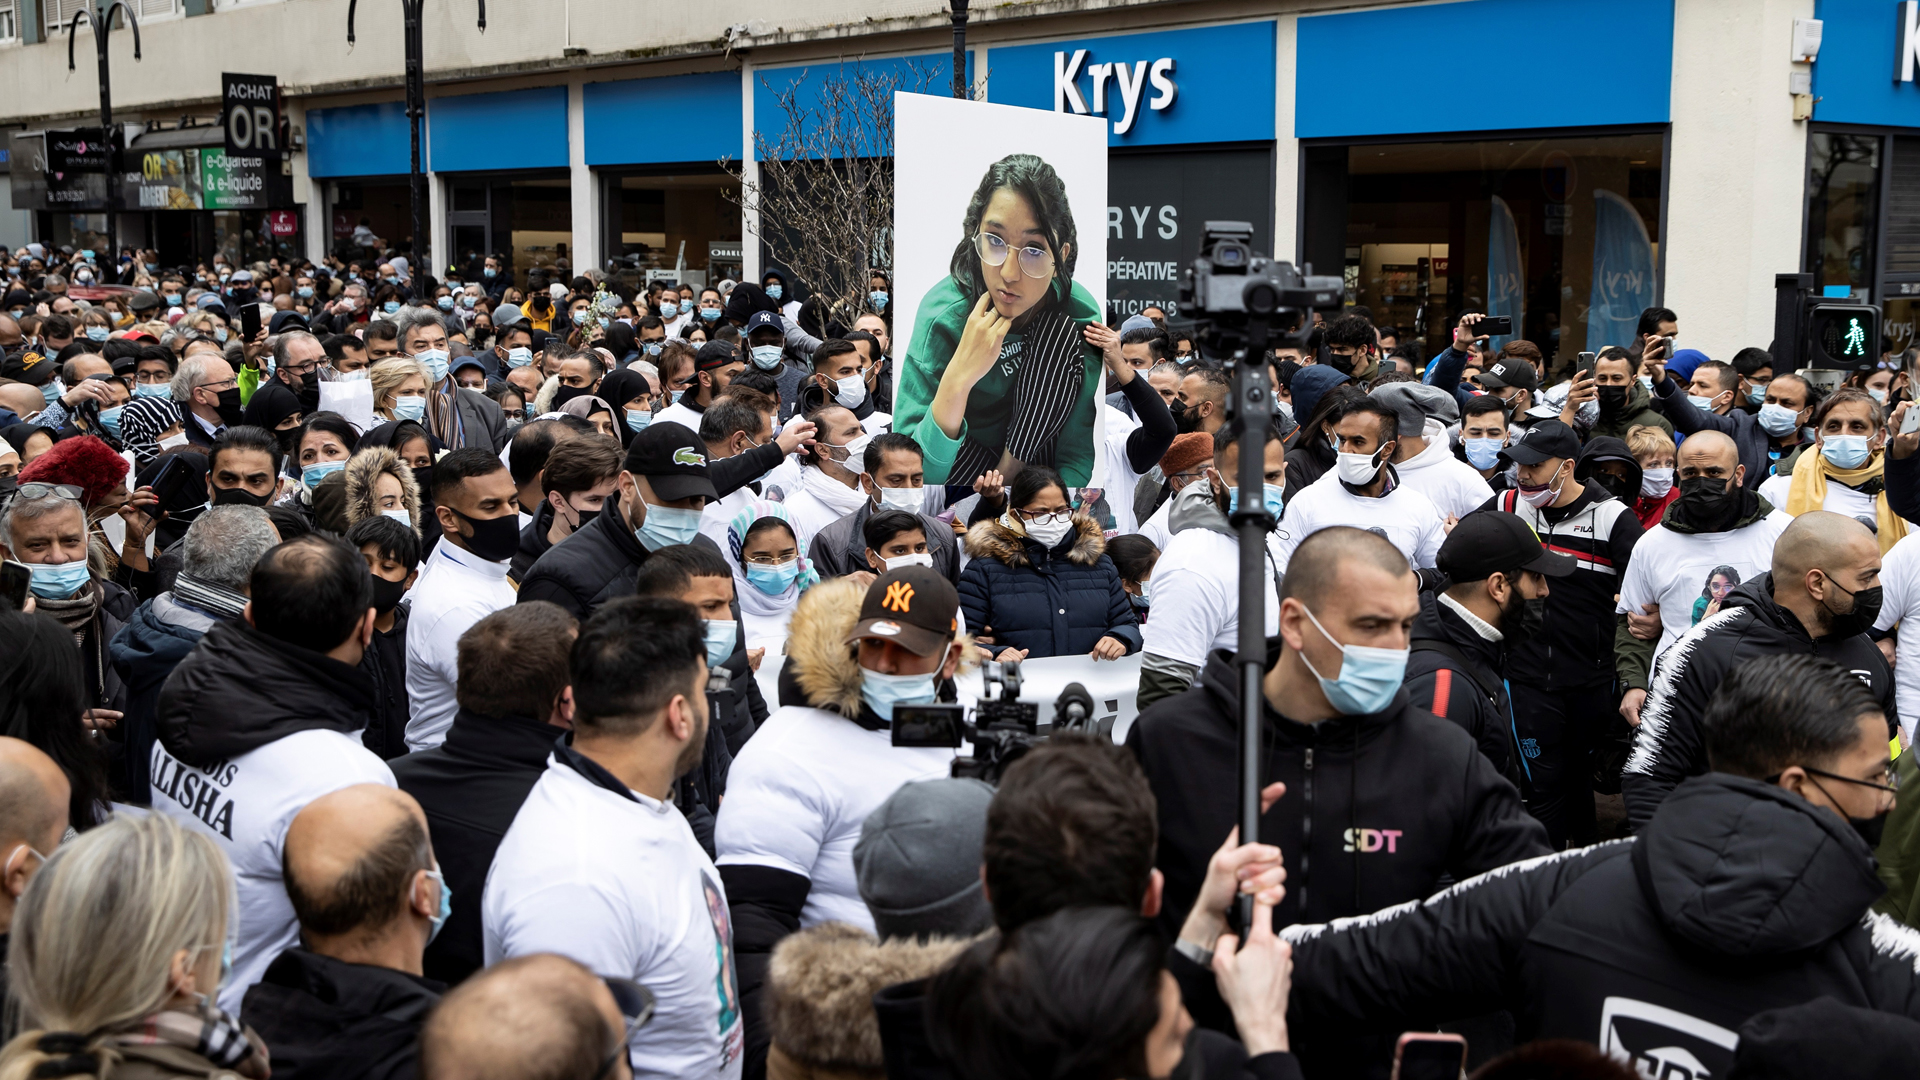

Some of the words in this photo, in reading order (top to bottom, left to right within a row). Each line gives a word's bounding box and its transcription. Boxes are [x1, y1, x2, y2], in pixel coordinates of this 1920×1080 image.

[228, 83, 273, 100] ACHAT
[1054, 48, 1177, 134] Krys
[229, 104, 276, 150] OR
[143, 153, 163, 181] OR
[207, 174, 216, 191] &
[217, 173, 263, 195] e-liquide
[1107, 256, 1178, 280] PÉRATIVE
[1883, 319, 1912, 342] Krys
[1573, 525, 1594, 533] FILA
[881, 580, 915, 613] NY
[151, 748, 234, 842] ALISHA
[1343, 827, 1403, 853] SDT
